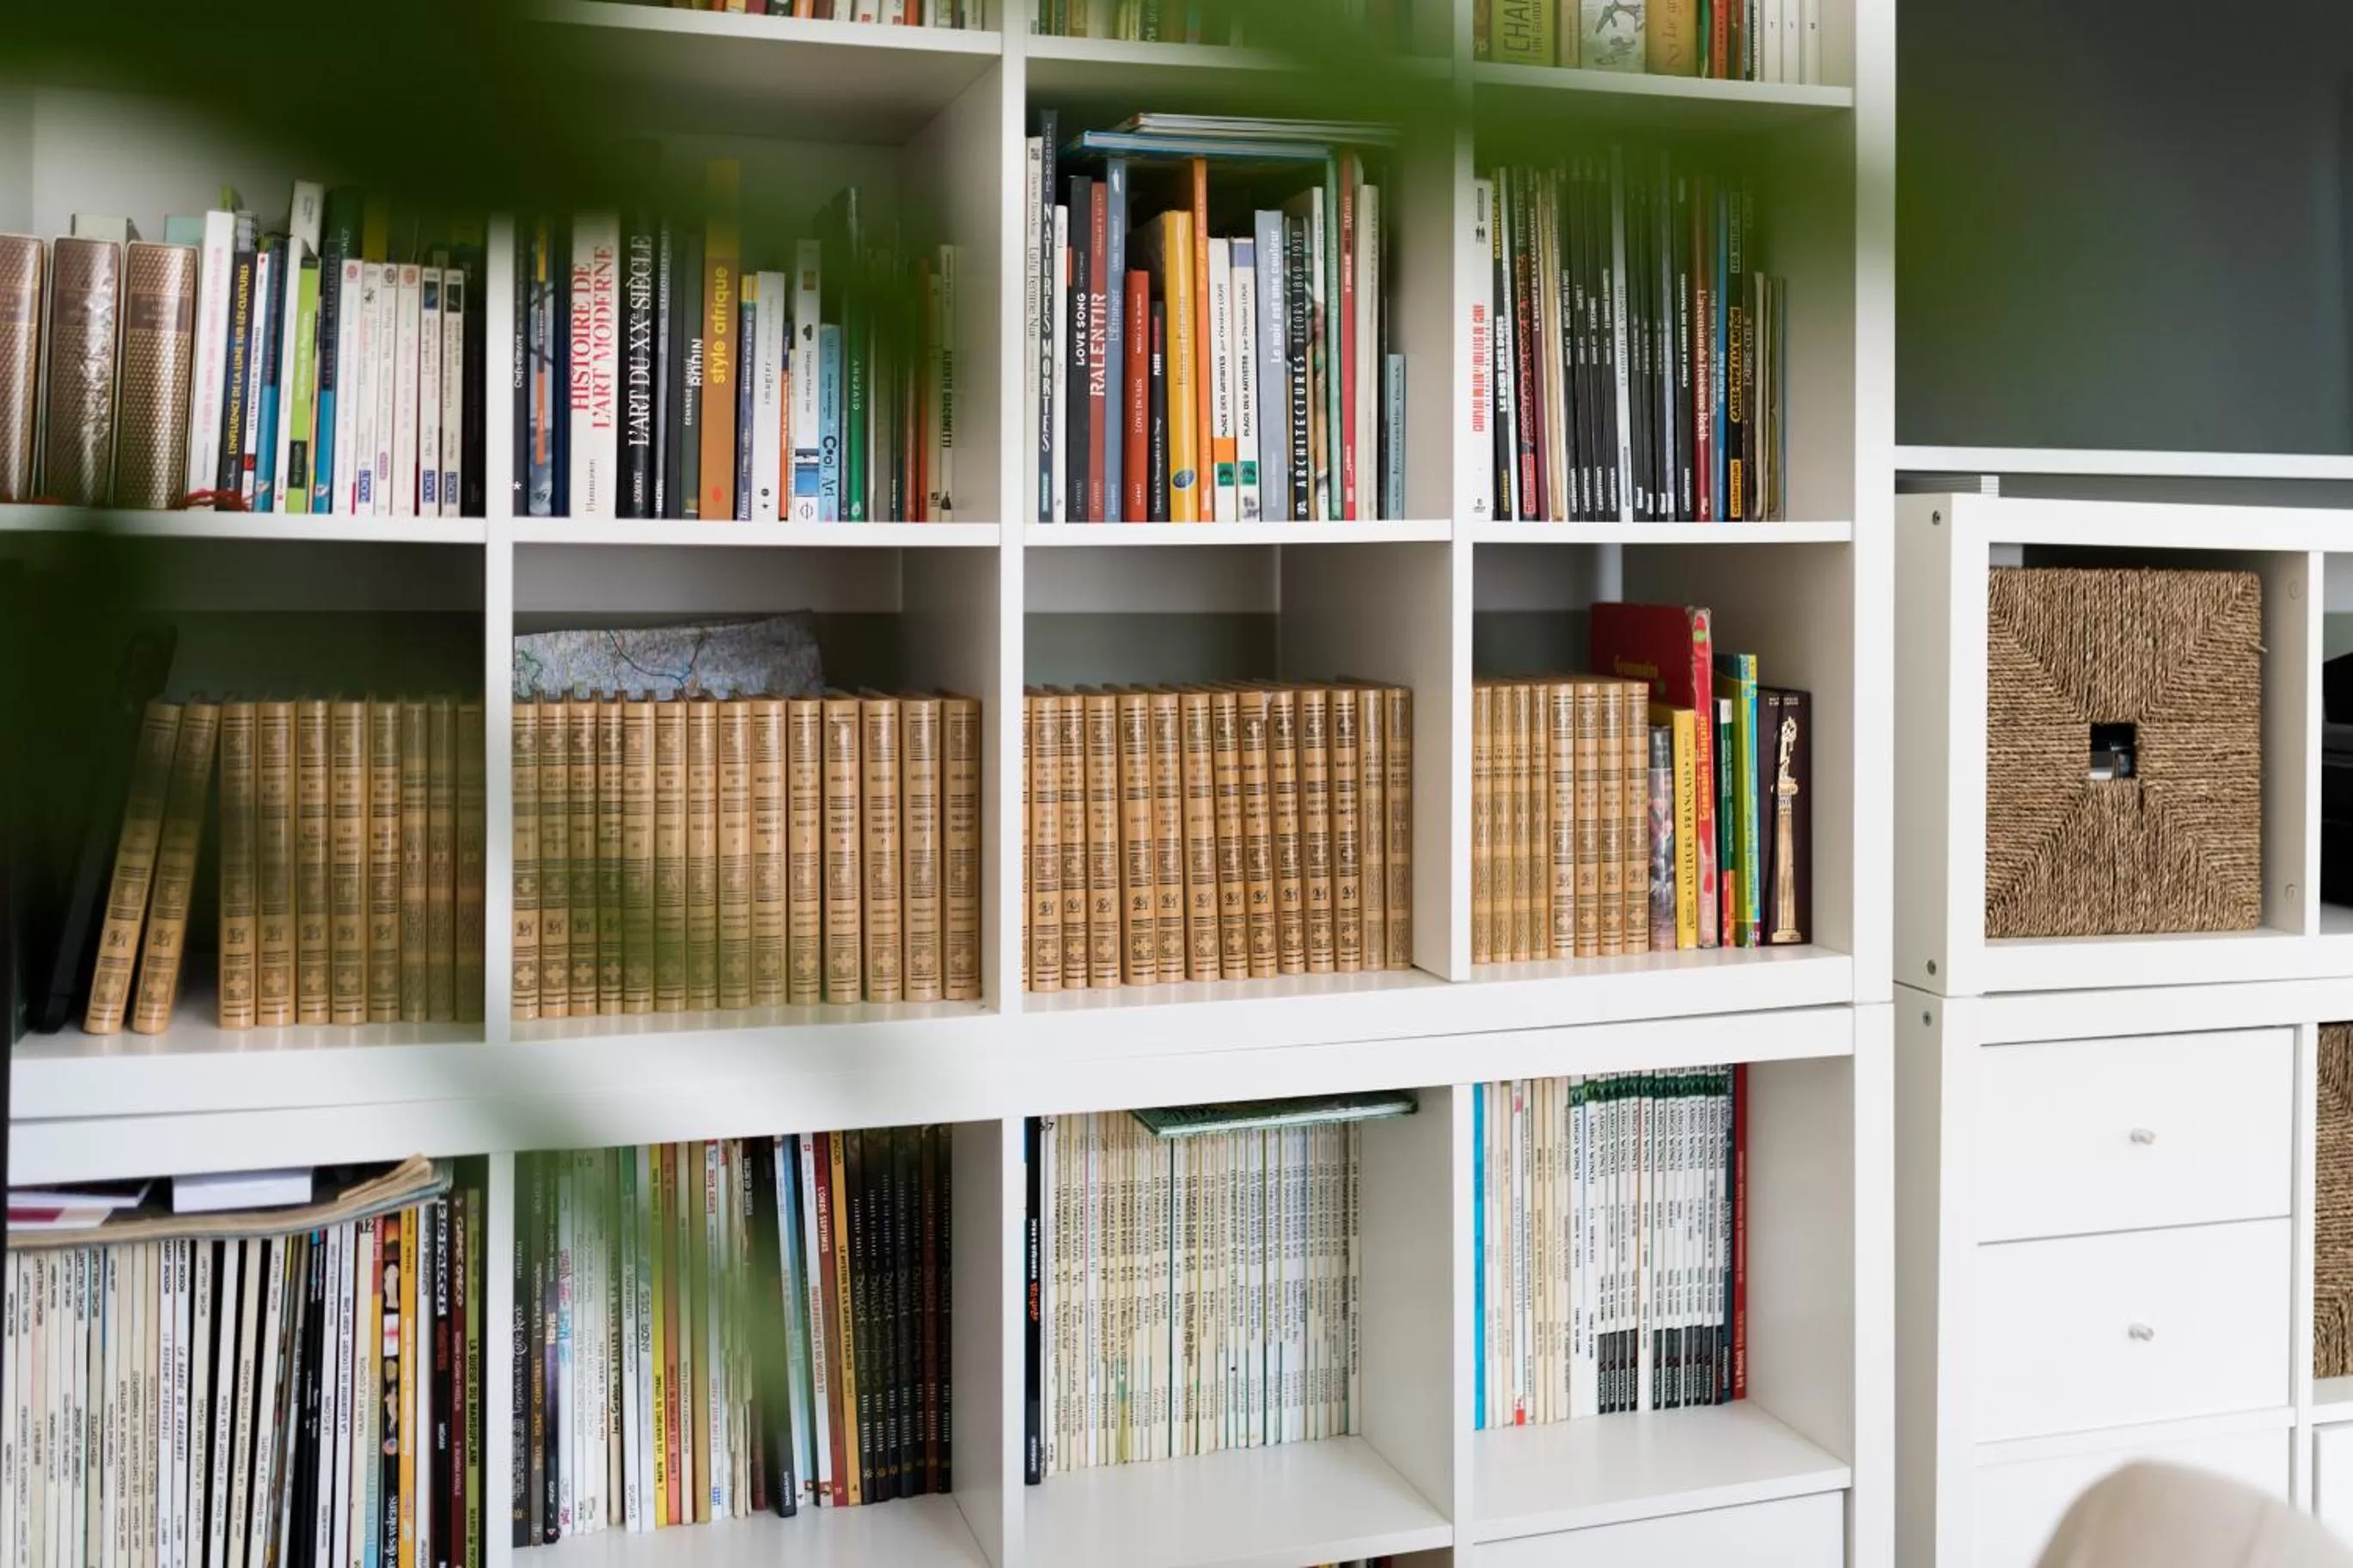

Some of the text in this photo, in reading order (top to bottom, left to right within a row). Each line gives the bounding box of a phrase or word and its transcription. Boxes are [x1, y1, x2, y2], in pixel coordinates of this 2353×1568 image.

[626, 235, 651, 309] SIÈCLE
[1290, 231, 1303, 257] 1930
[1269, 229, 1281, 363] Le noir est une couleur
[1291, 266, 1303, 293] 1860
[571, 263, 590, 411] HISTOIRE DE
[592, 246, 613, 428] L'ART MODERNE
[710, 266, 730, 383] style afrique
[1042, 203, 1052, 452] NATURES MORTES
[1076, 292, 1086, 327] SONG
[1107, 290, 1120, 341] L'Étranger
[1495, 316, 1505, 344] DERS
[1730, 308, 1740, 348] NATION
[228, 265, 248, 454] L'INFLUENCE DE LA LUNE SUR LES CULTURES
[631, 358, 651, 386] DU
[692, 339, 702, 386] RODIN
[1076, 332, 1086, 365] LOVE
[1090, 292, 1106, 396] RALENTIR
[1497, 347, 1506, 369] DES
[629, 390, 651, 446] L'ART
[1293, 355, 1306, 487] ARCHITECTURES
[1499, 399, 1507, 412] LE
[1697, 412, 1708, 441] Reich
[1696, 715, 1710, 821] Grammaire française
[1683, 769, 1693, 885] AUTEURS FRANÇAIS
[362, 1214, 374, 1232] 12
[91, 1248, 101, 1317] MICHEL VAILLANT
[468, 1339, 478, 1467] LA QUEUE DU MARSUPILAMI
[611, 1384, 620, 1413] Graton
[385, 1495, 399, 1555] des volcans
